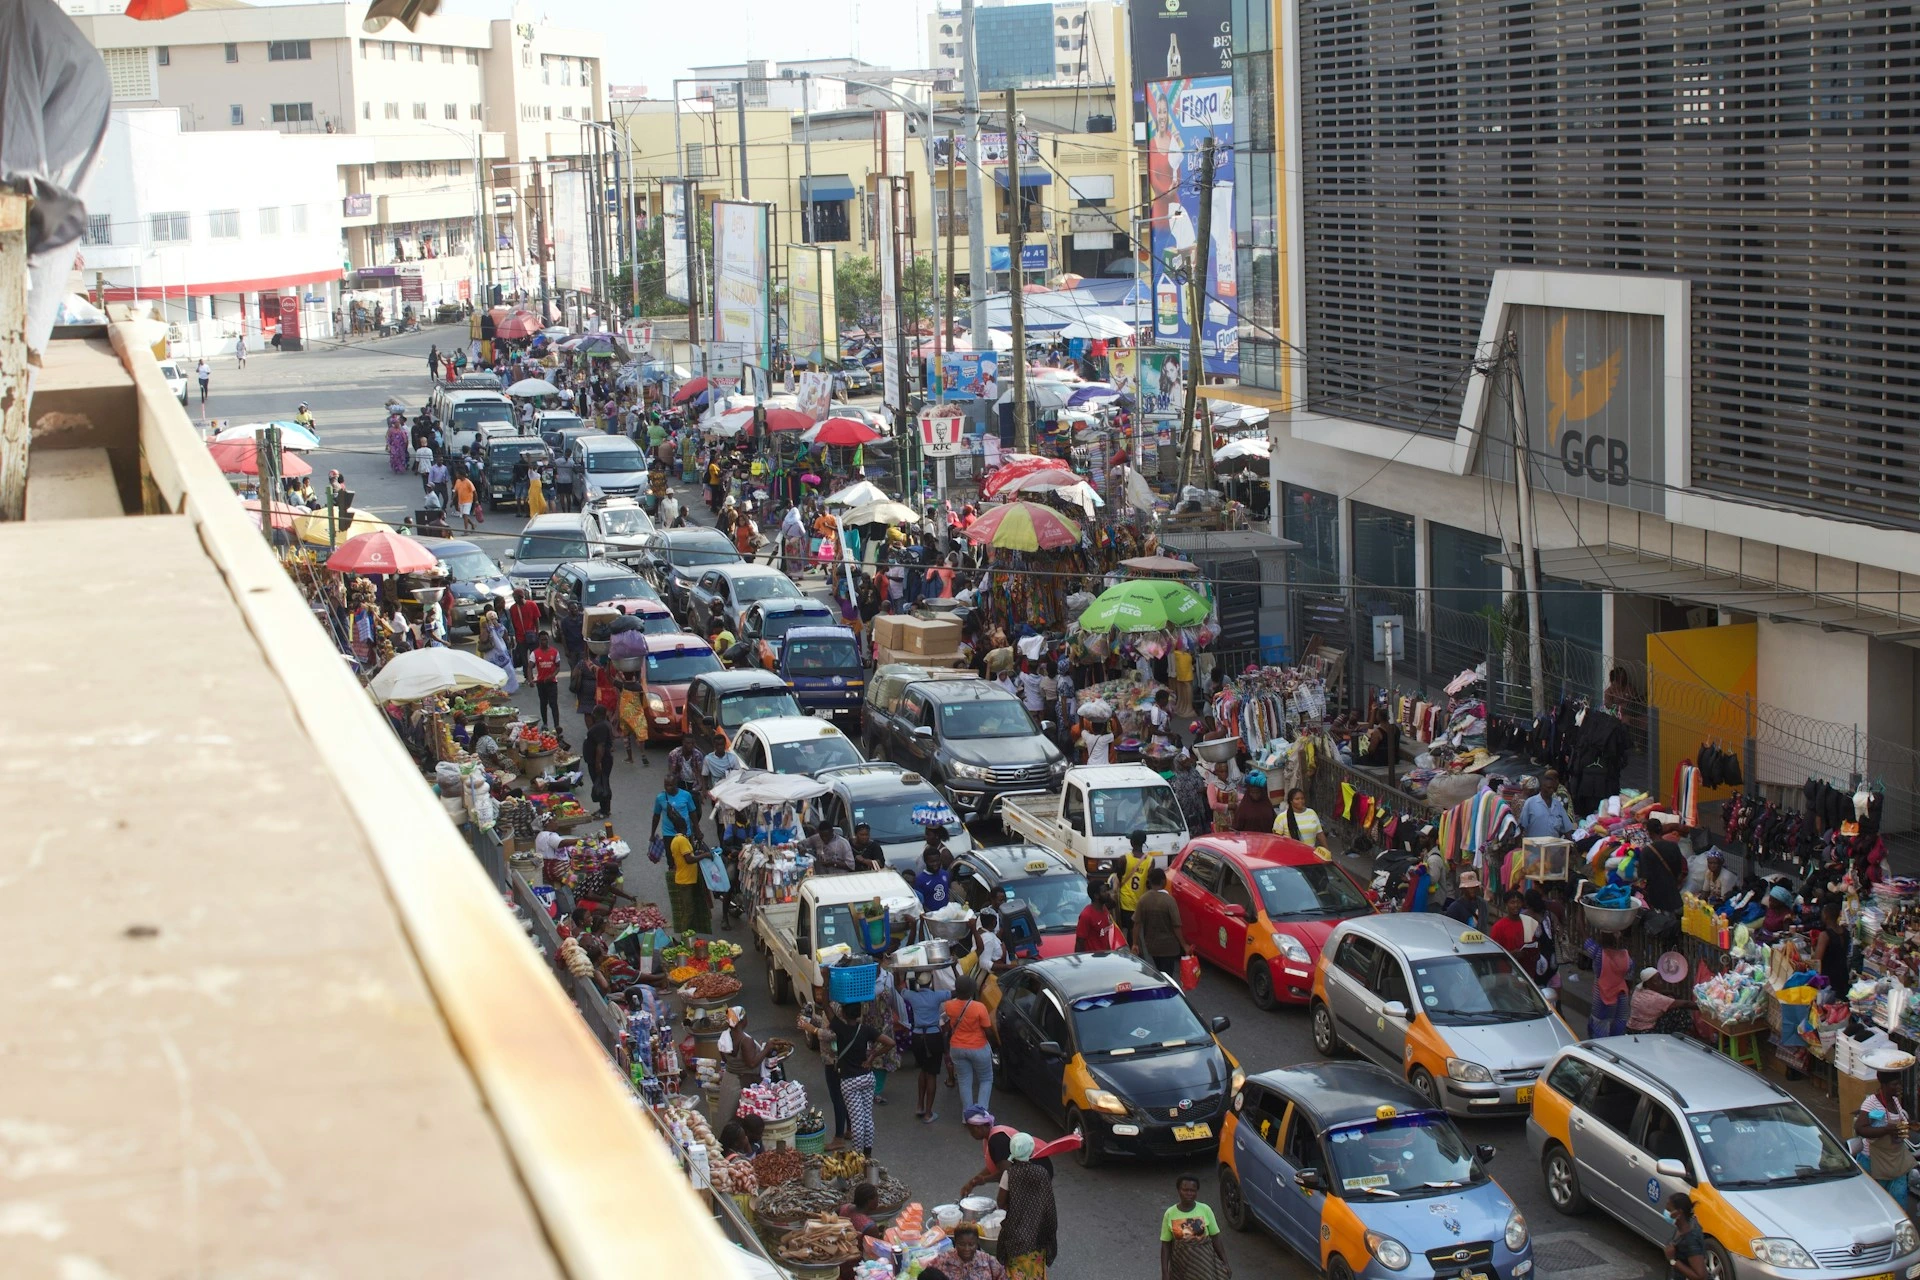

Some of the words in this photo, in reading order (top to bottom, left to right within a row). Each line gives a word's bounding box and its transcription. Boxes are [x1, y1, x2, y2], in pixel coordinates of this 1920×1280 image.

[1182, 92, 1218, 123] Flora
[932, 443, 952, 451] KFC
[1560, 429, 1629, 487] GCB
[1131, 876, 1140, 890] 6
[1381, 1110, 1396, 1118] TAXI
[1735, 1125, 1756, 1134] TAXI
[1648, 1183, 1659, 1198] 224
